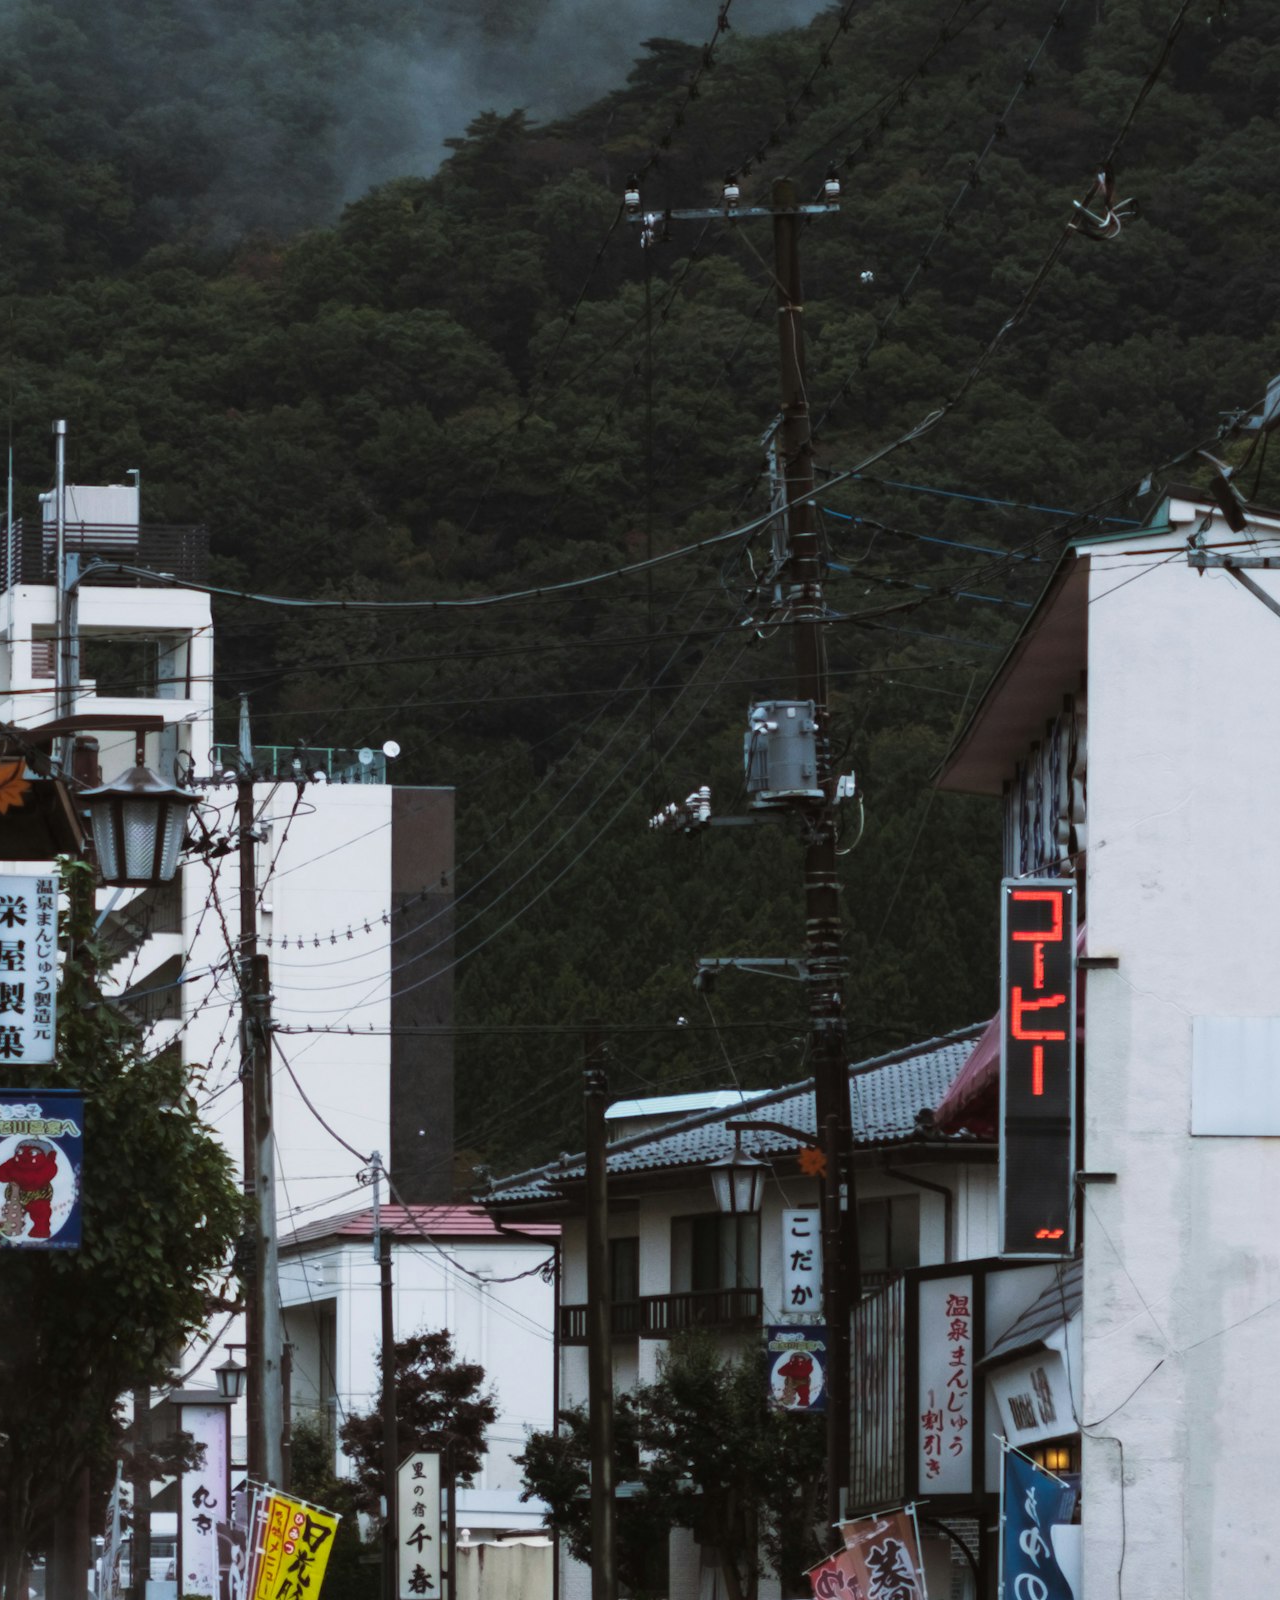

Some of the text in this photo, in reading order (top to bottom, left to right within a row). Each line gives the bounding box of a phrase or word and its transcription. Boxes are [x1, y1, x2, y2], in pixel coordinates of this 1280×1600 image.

[32, 879, 54, 1040] 温泉まんじゅう製造元
[1011, 891, 1066, 1096] コーヒー
[790, 1217, 813, 1306] こだか
[945, 1293, 971, 1457] 温泉まんじゅう
